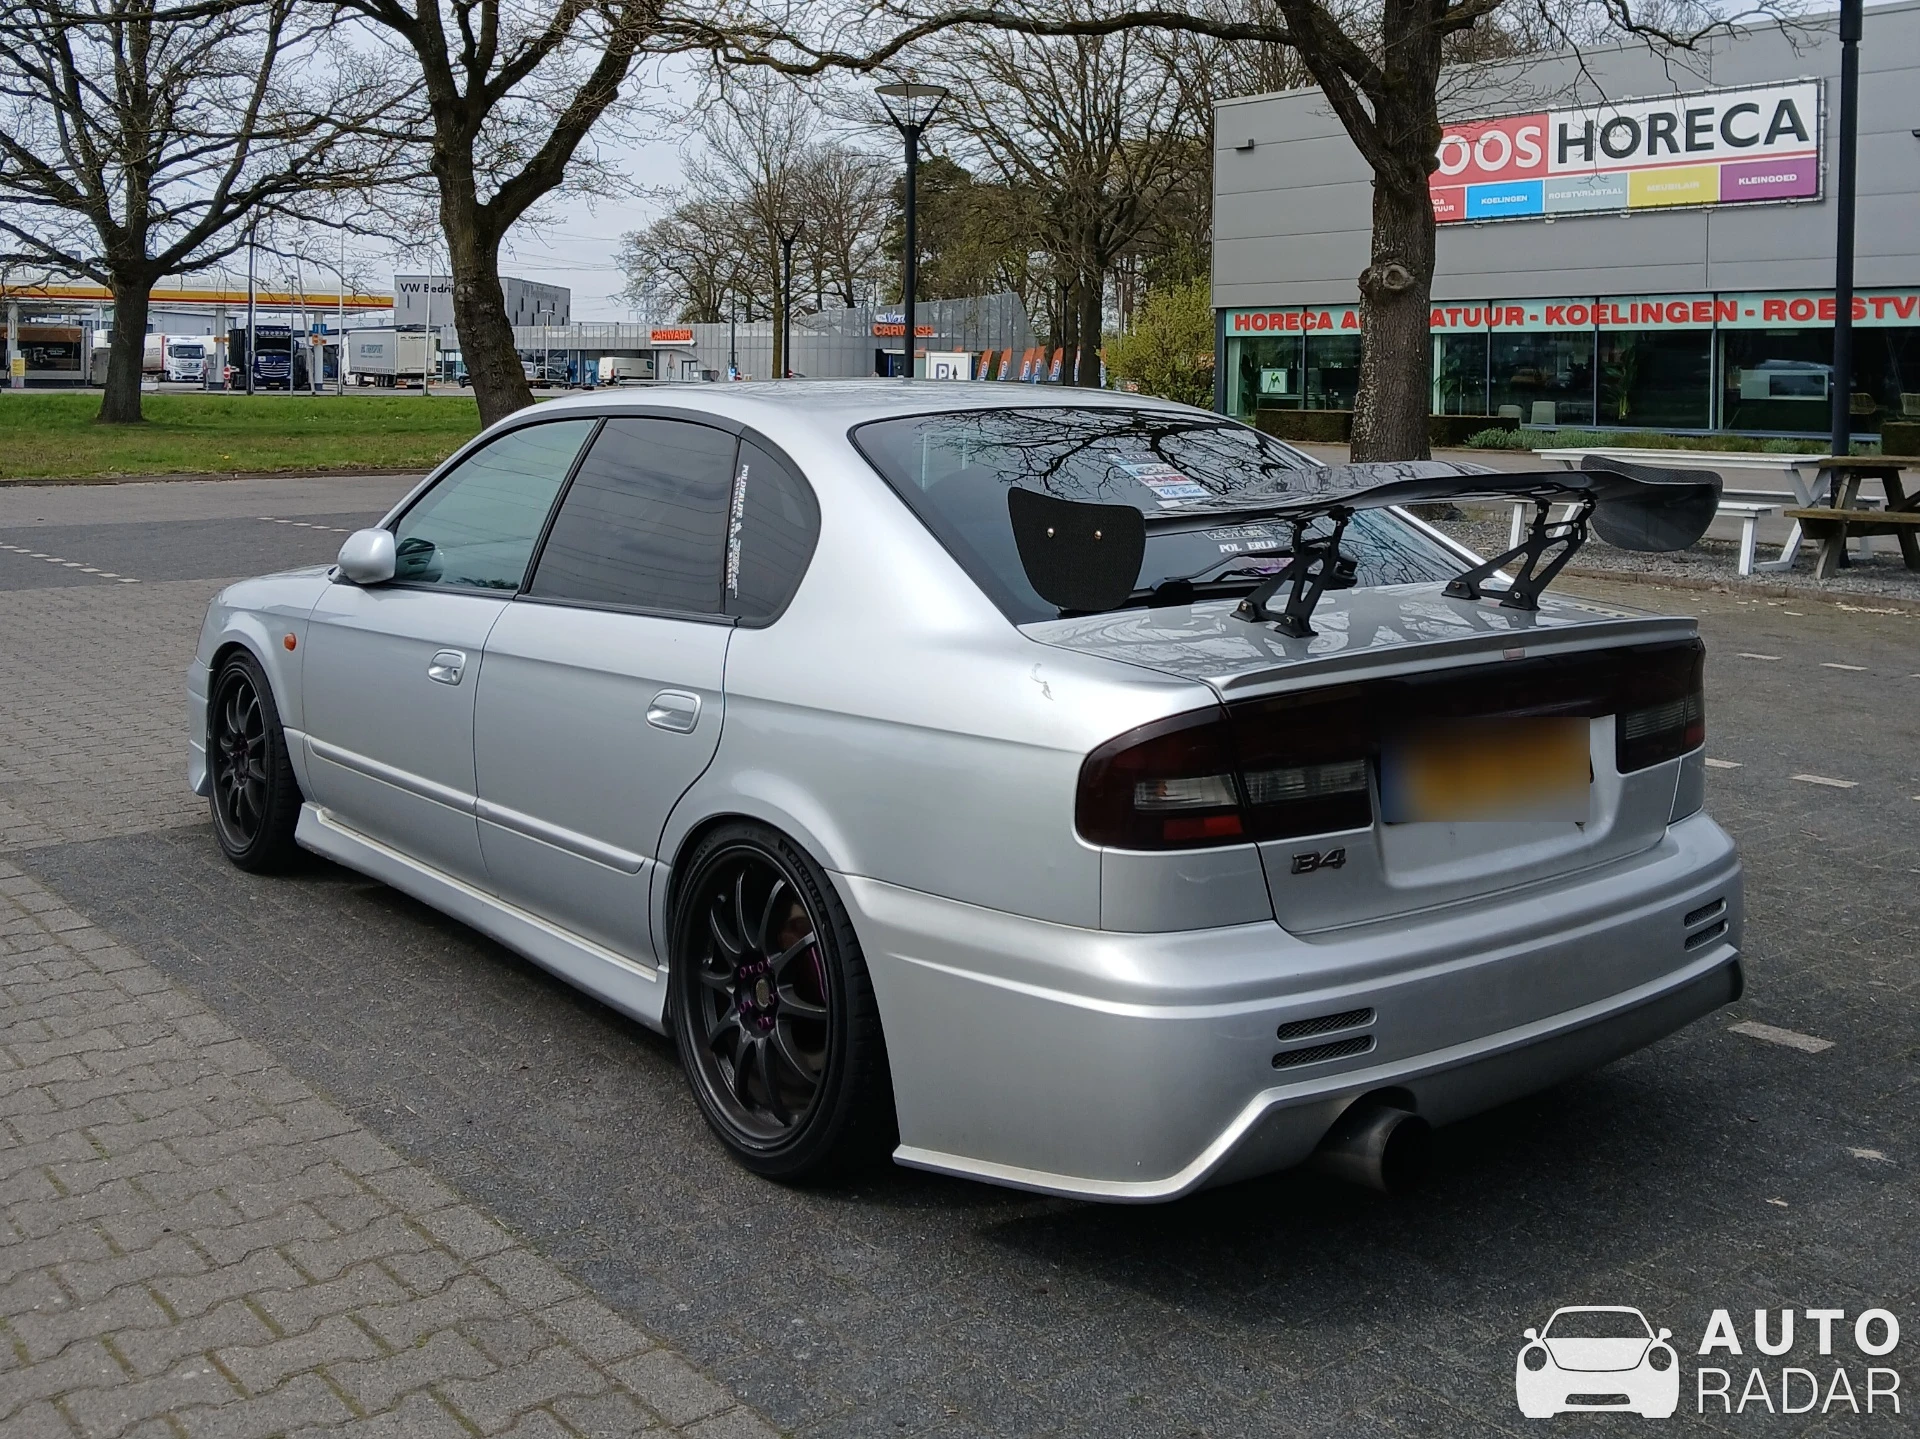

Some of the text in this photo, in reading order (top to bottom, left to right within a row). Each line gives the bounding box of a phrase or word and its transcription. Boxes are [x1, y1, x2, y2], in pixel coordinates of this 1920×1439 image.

[1557, 98, 1810, 164] HORECA
[1738, 173, 1798, 186] KLEINGOED
[1646, 181, 1700, 192] MEUBILAIR
[1480, 194, 1528, 205] KOELINGEN
[1548, 188, 1624, 200] ROESTVRIJSTAAL
[400, 283, 421, 293] VW
[1234, 311, 1333, 331] HORECA
[1545, 300, 1738, 326] KOELINGEN
[1763, 296, 1920, 322] ROESTV
[650, 329, 692, 340] CARWASH
[736, 464, 749, 518] POLDERLIFE
[1291, 847, 1346, 875] B4
